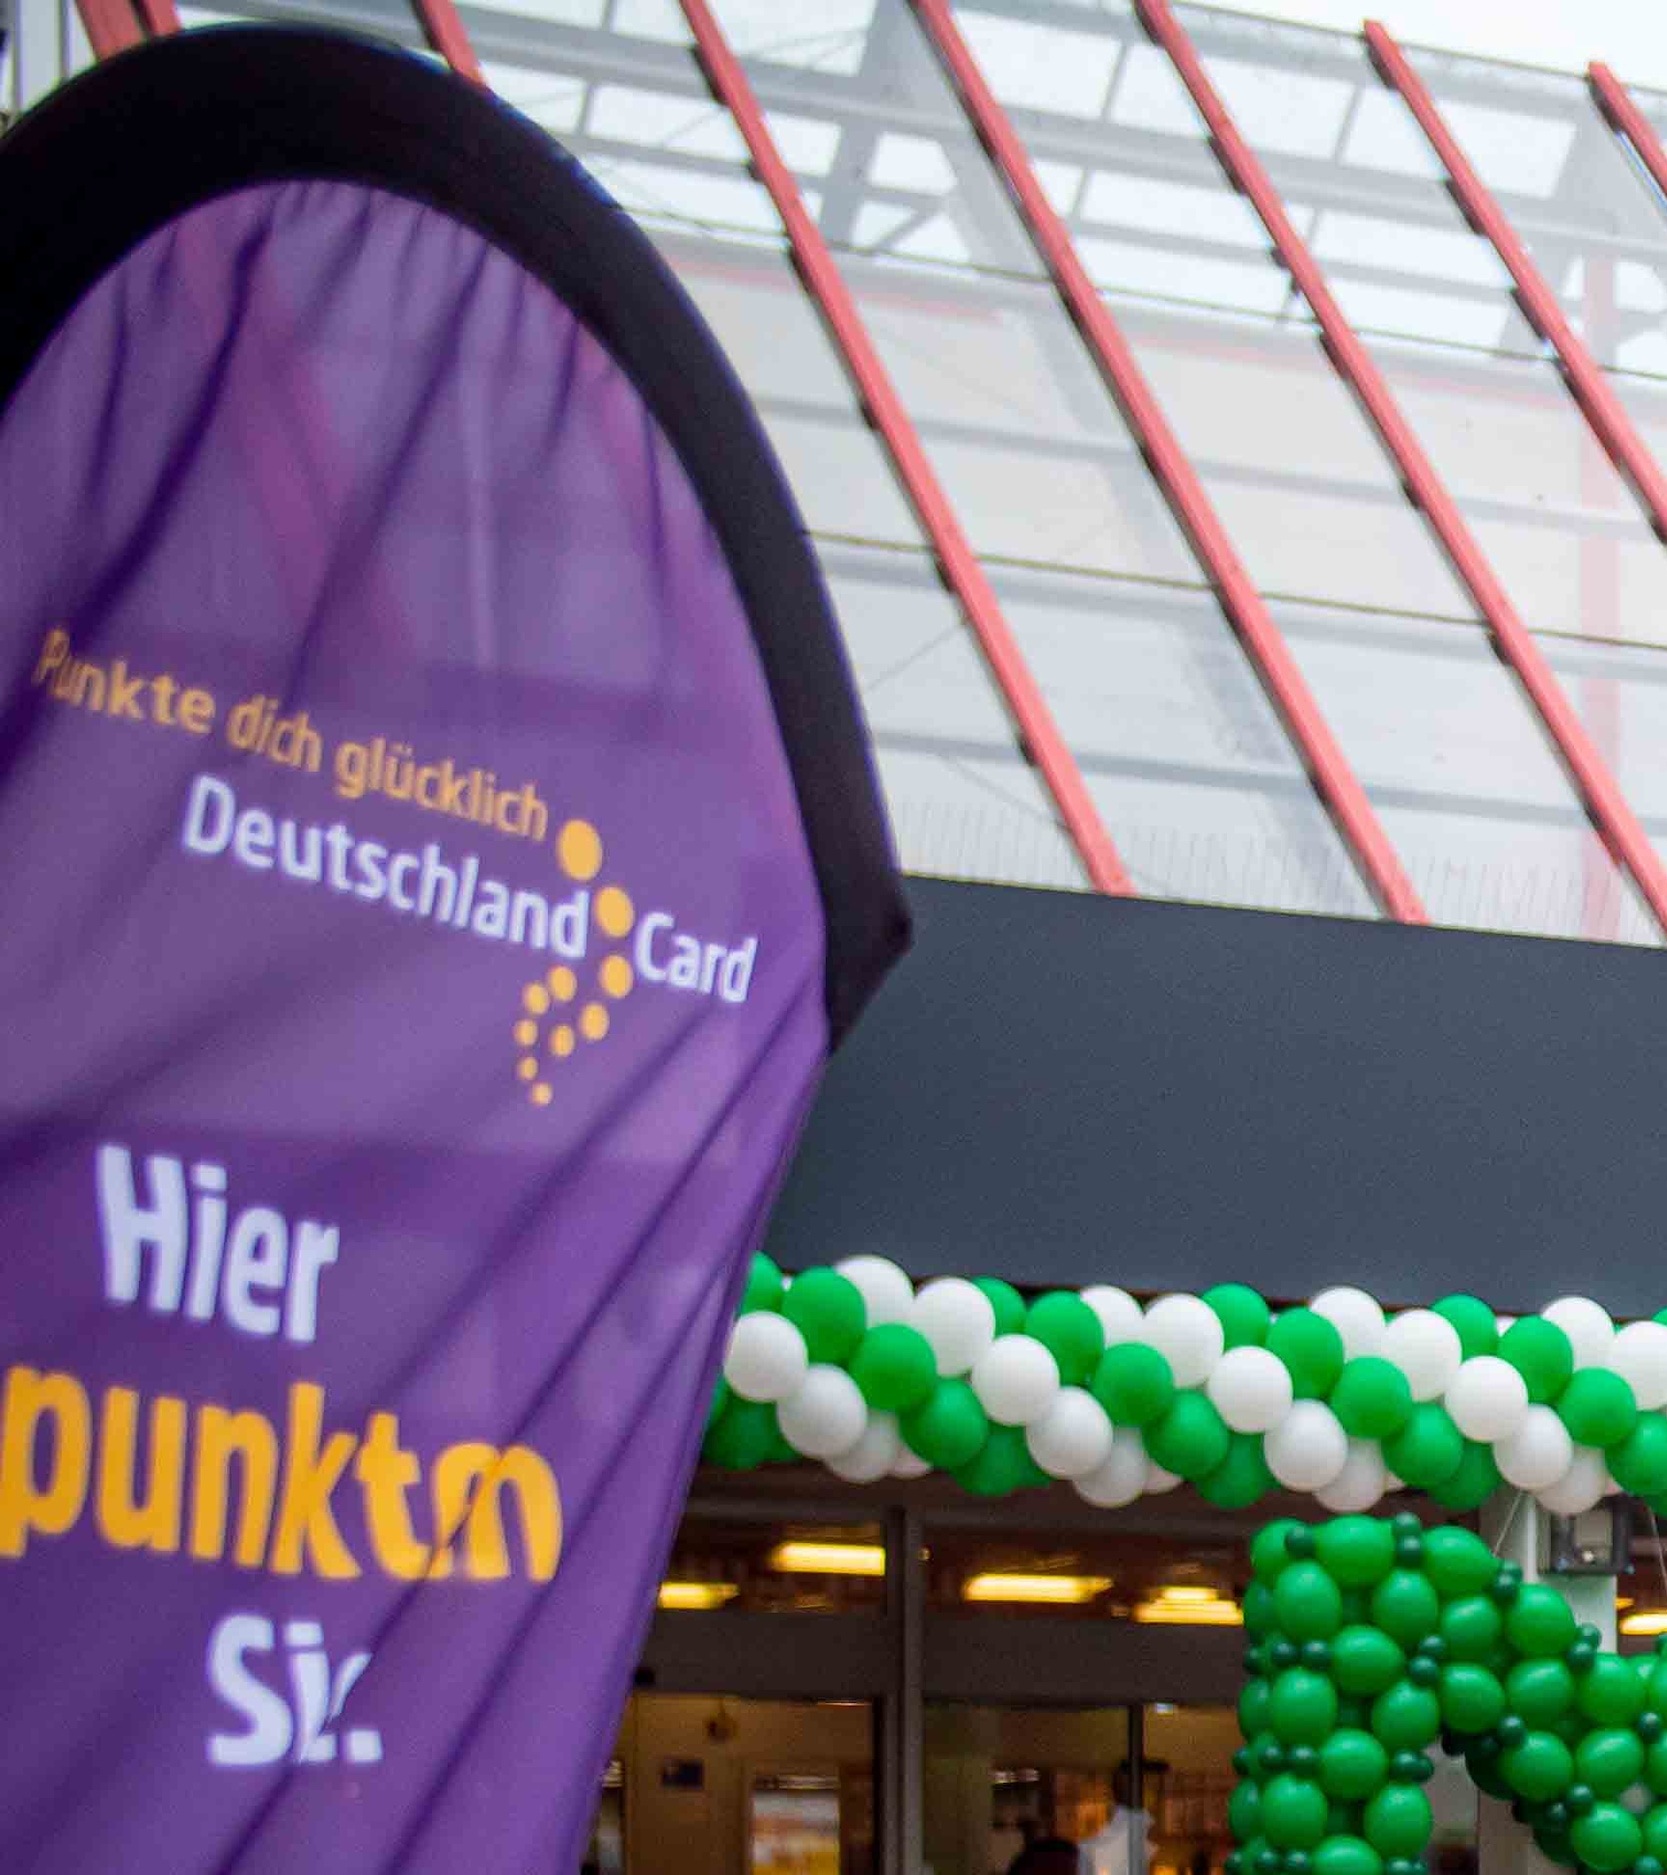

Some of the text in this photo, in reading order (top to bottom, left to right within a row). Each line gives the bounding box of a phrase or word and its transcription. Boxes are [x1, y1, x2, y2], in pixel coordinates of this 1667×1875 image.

[33, 626, 548, 840] Punkte dich glücklich
[182, 774, 759, 1003] Deutschland Card
[97, 1144, 340, 1343] Hier
